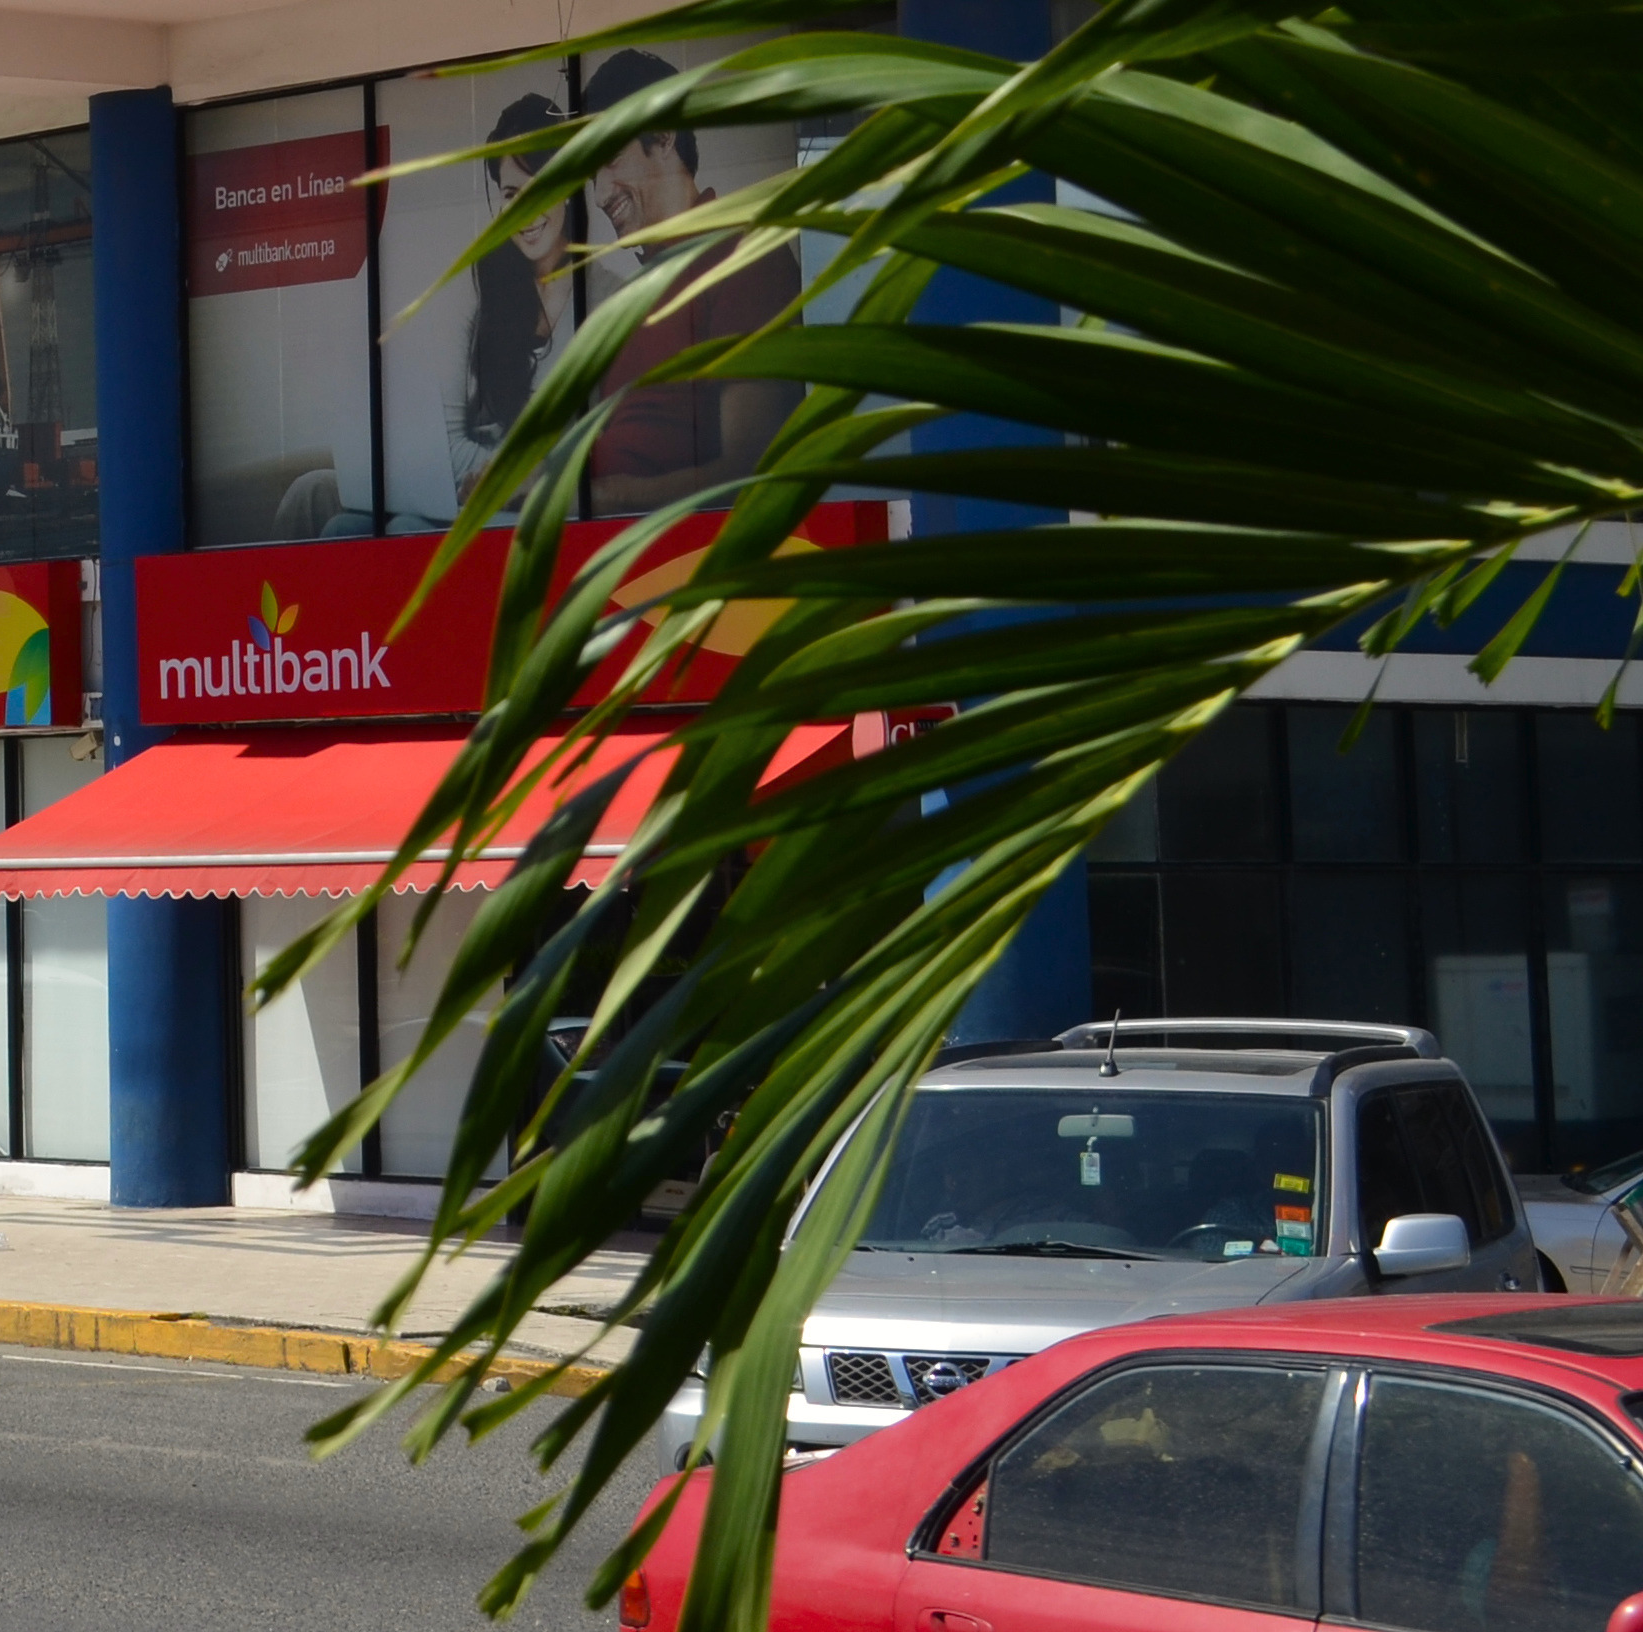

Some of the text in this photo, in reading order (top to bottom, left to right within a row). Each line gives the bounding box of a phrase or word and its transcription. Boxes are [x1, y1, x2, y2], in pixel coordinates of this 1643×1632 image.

[216, 172, 345, 210] Banca en Línea
[238, 239, 335, 267] multibank.com.pa
[159, 631, 391, 700] multibank
